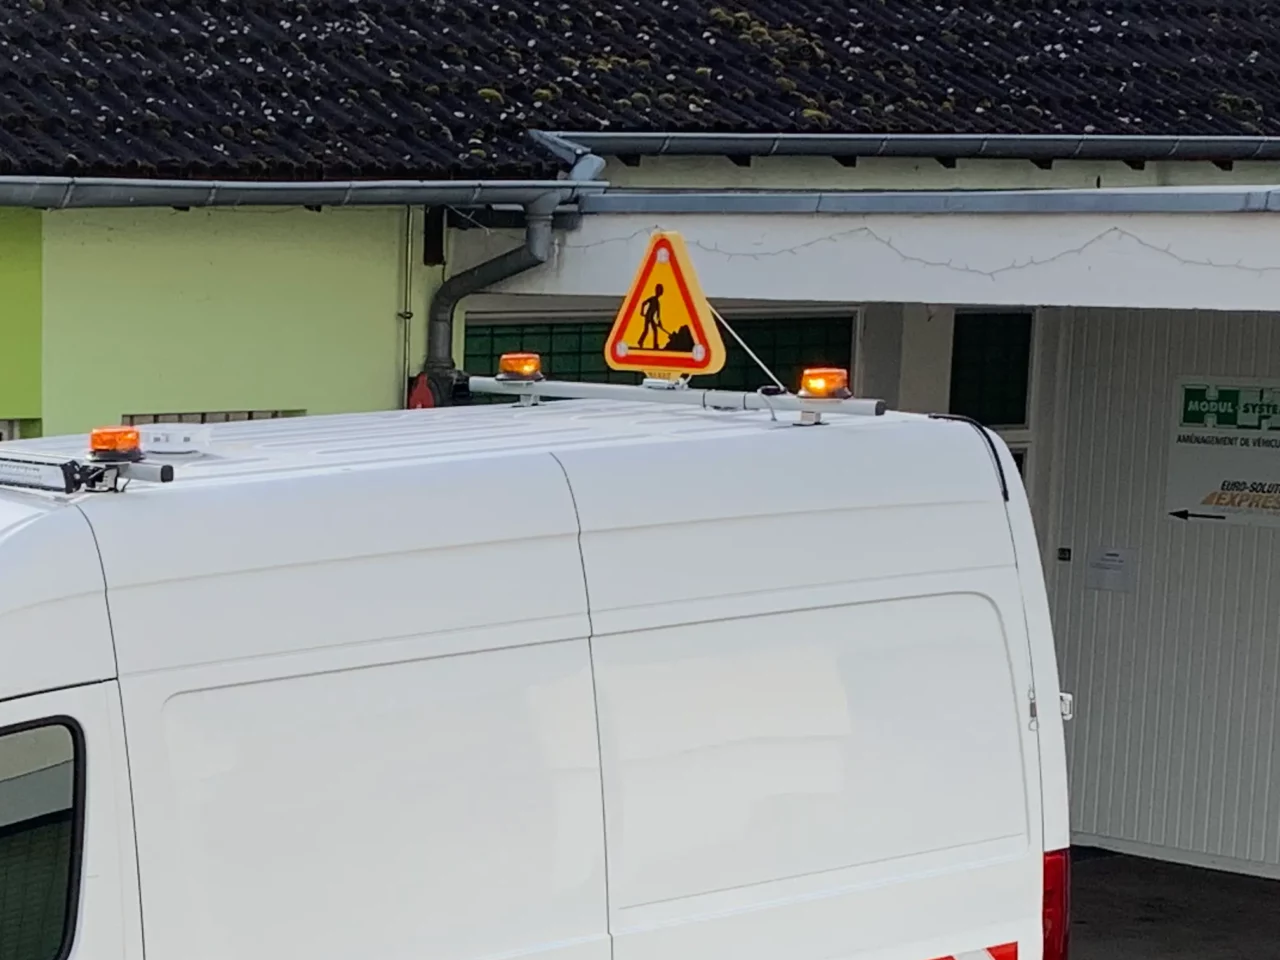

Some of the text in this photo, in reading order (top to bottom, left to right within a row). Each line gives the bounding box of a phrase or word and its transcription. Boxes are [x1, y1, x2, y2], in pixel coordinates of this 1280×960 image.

[1243, 403, 1280, 414] SYSTE
[1240, 437, 1250, 447] DE
[1220, 480, 1280, 494] EURO-SOLUT
